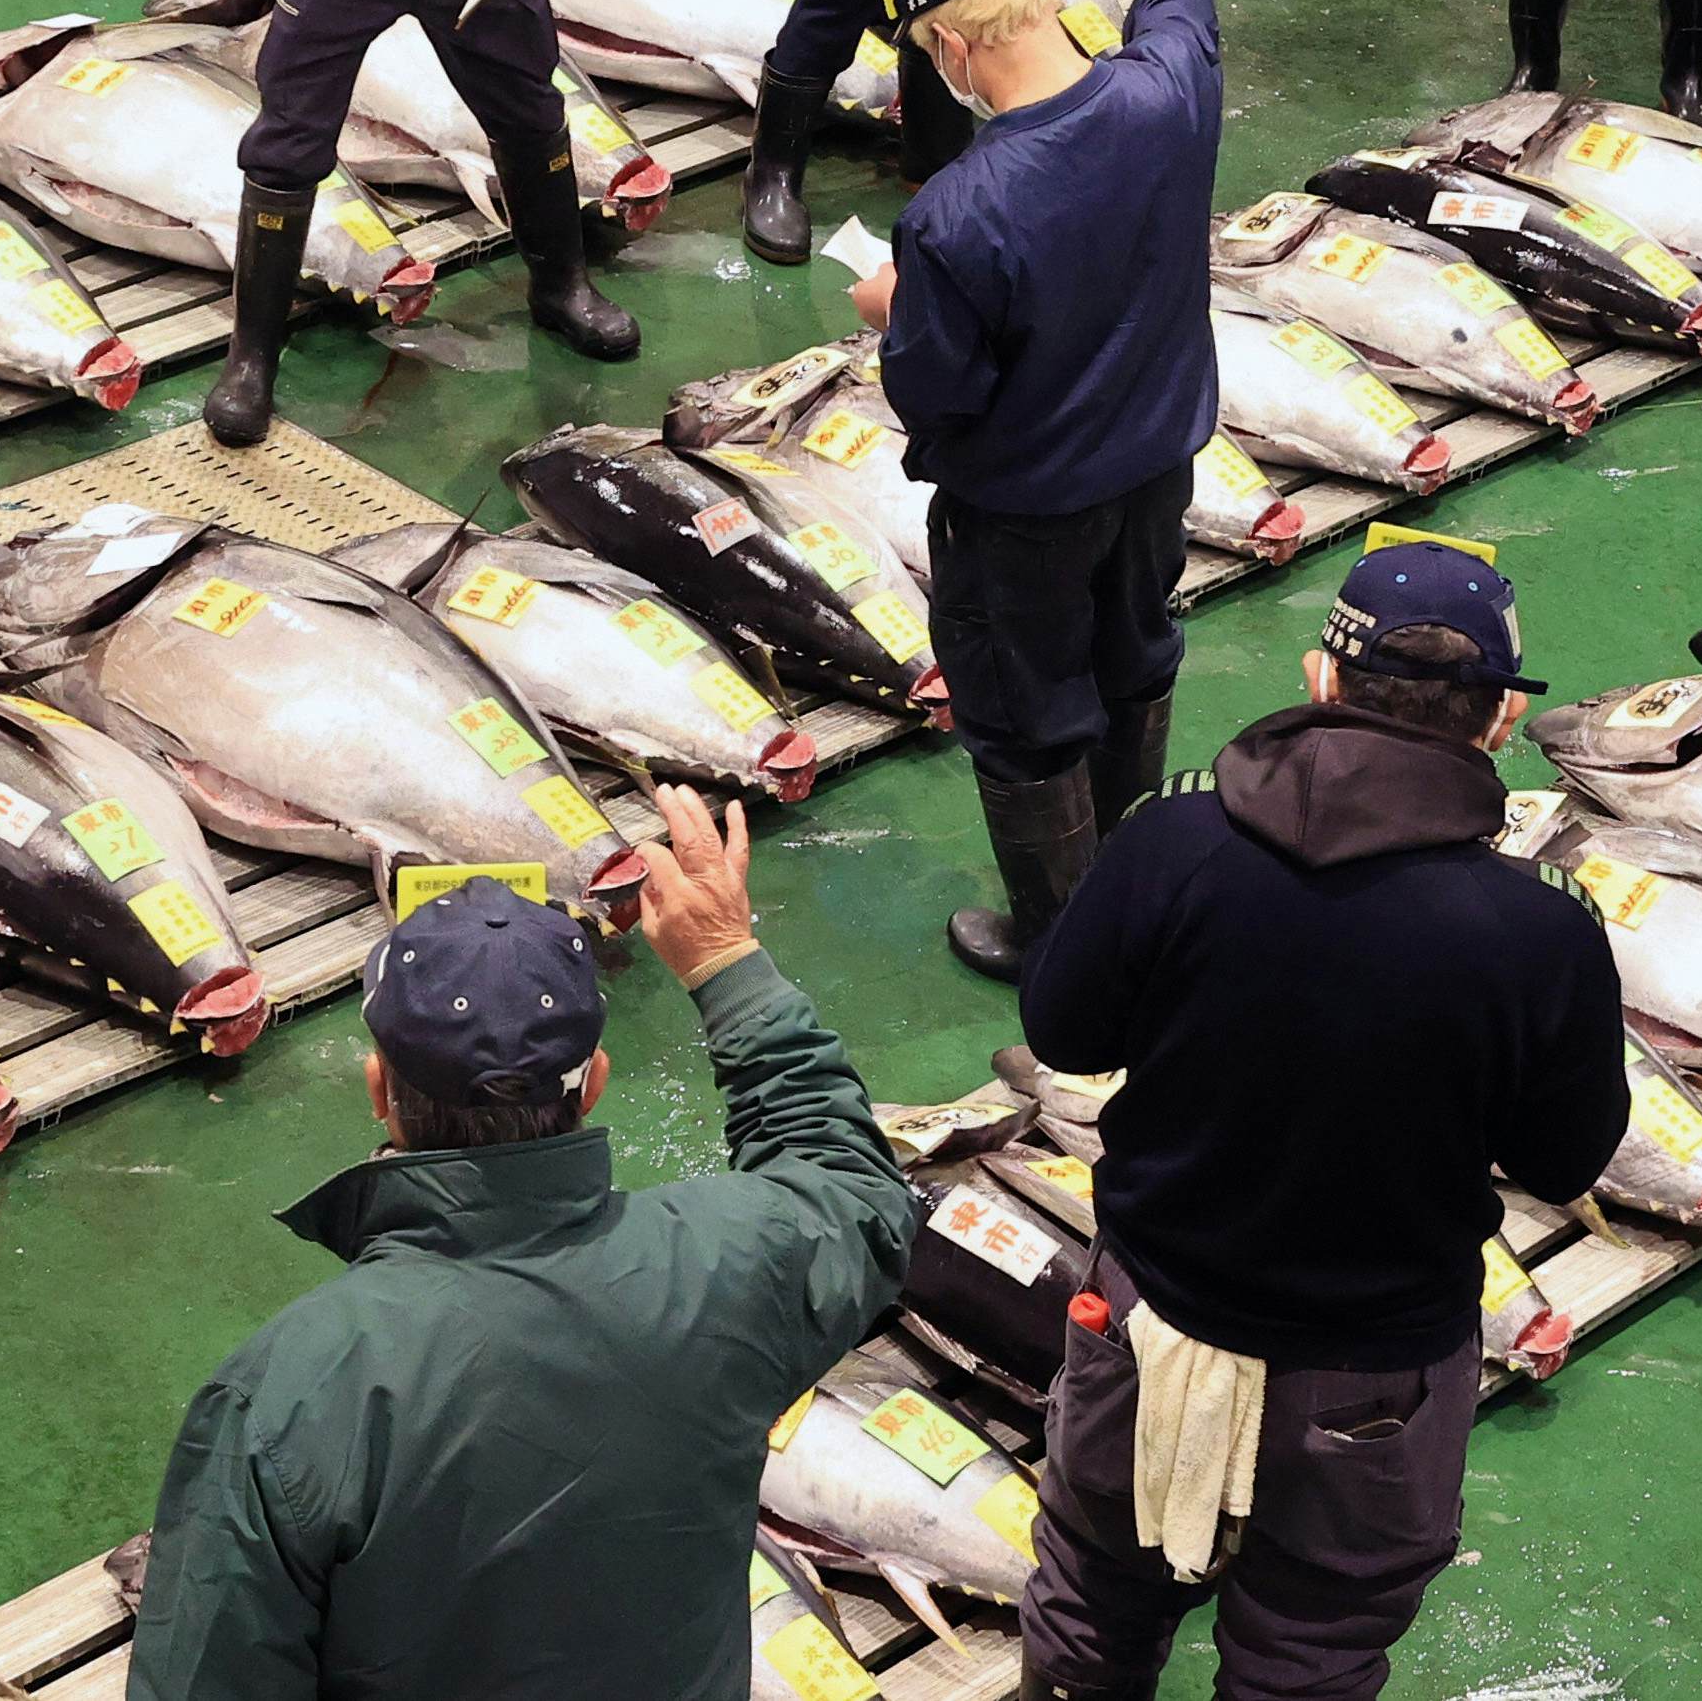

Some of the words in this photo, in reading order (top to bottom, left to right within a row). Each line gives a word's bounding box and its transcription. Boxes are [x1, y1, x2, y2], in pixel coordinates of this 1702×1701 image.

[827, 548, 856, 569] 30
[949, 1200, 1039, 1266] 東市行
[918, 1419, 956, 1456] 46
